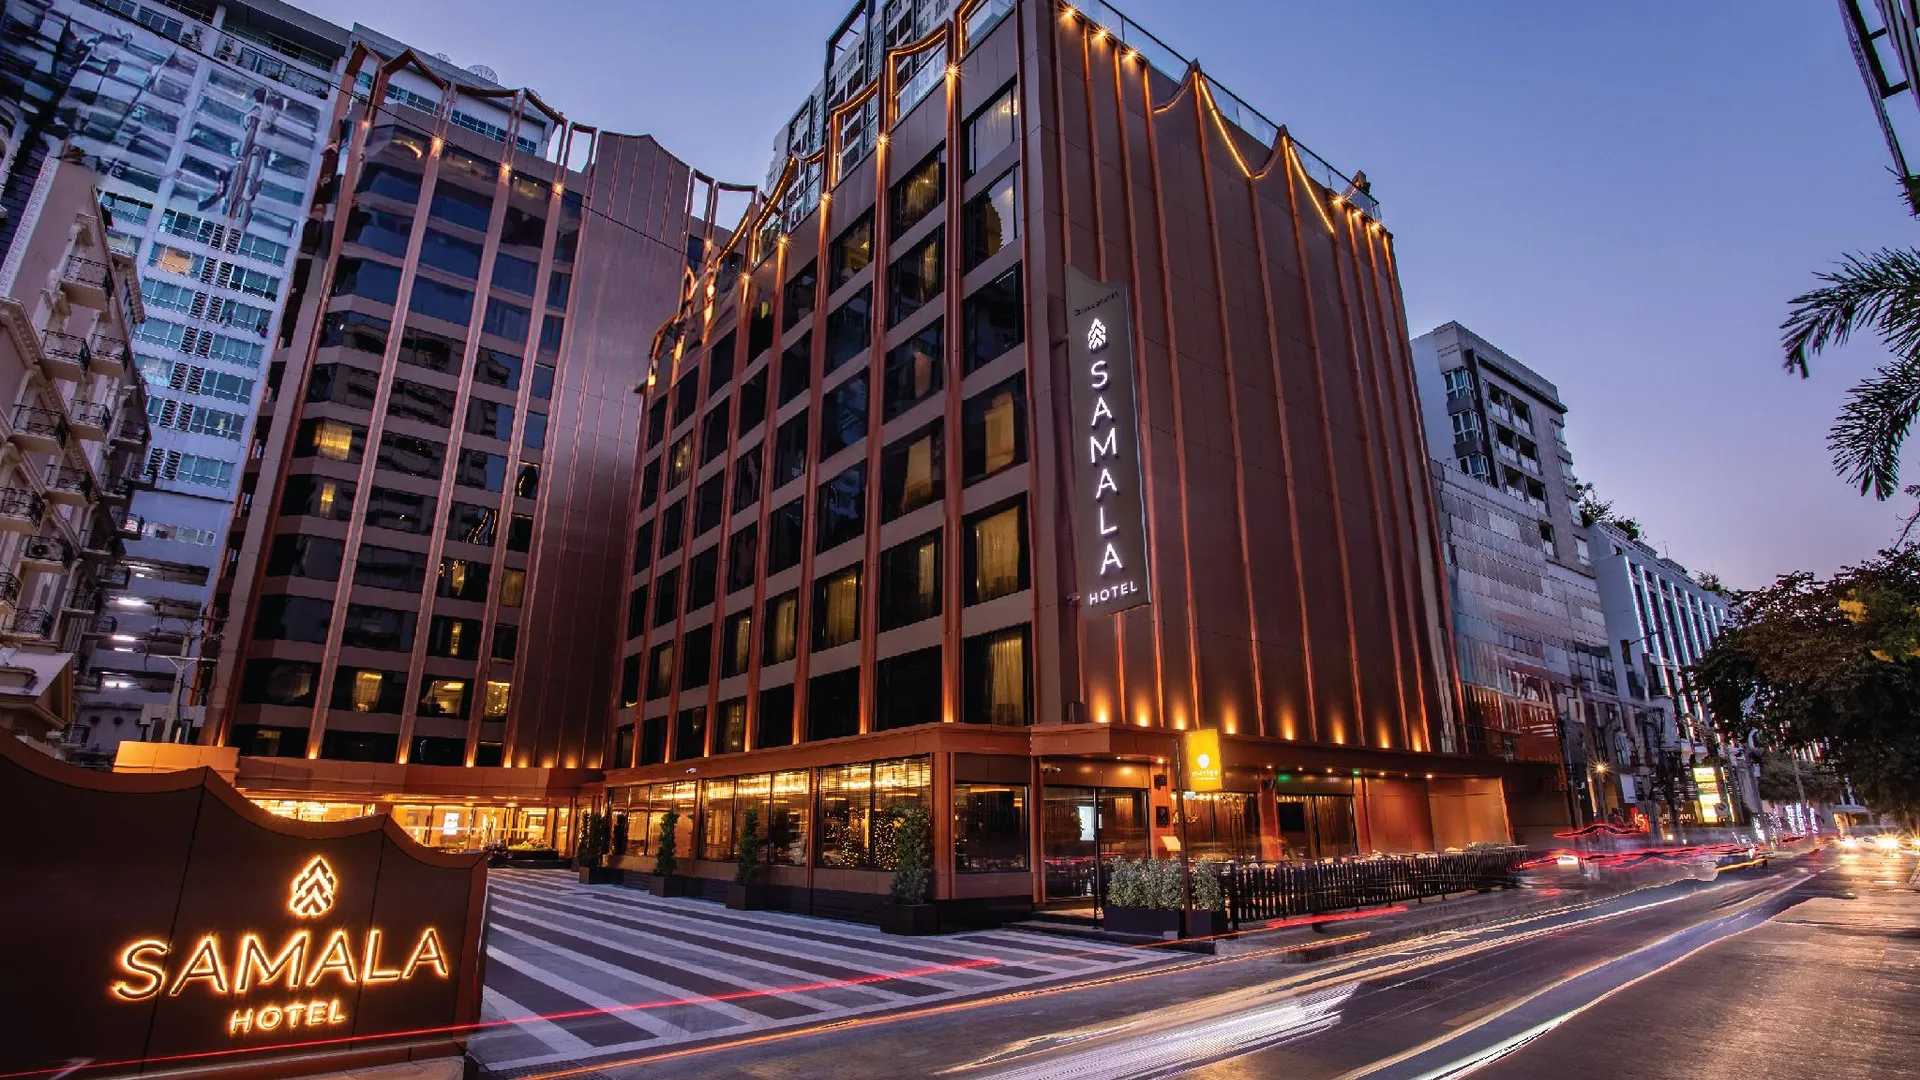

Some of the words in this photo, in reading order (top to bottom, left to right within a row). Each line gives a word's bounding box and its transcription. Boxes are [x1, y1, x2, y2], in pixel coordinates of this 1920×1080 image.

[1089, 360, 1123, 576] SAMALA
[1089, 581, 1138, 606] HOTEL
[112, 927, 449, 1001] SAMALA
[228, 1000, 346, 1034] HOTEL
